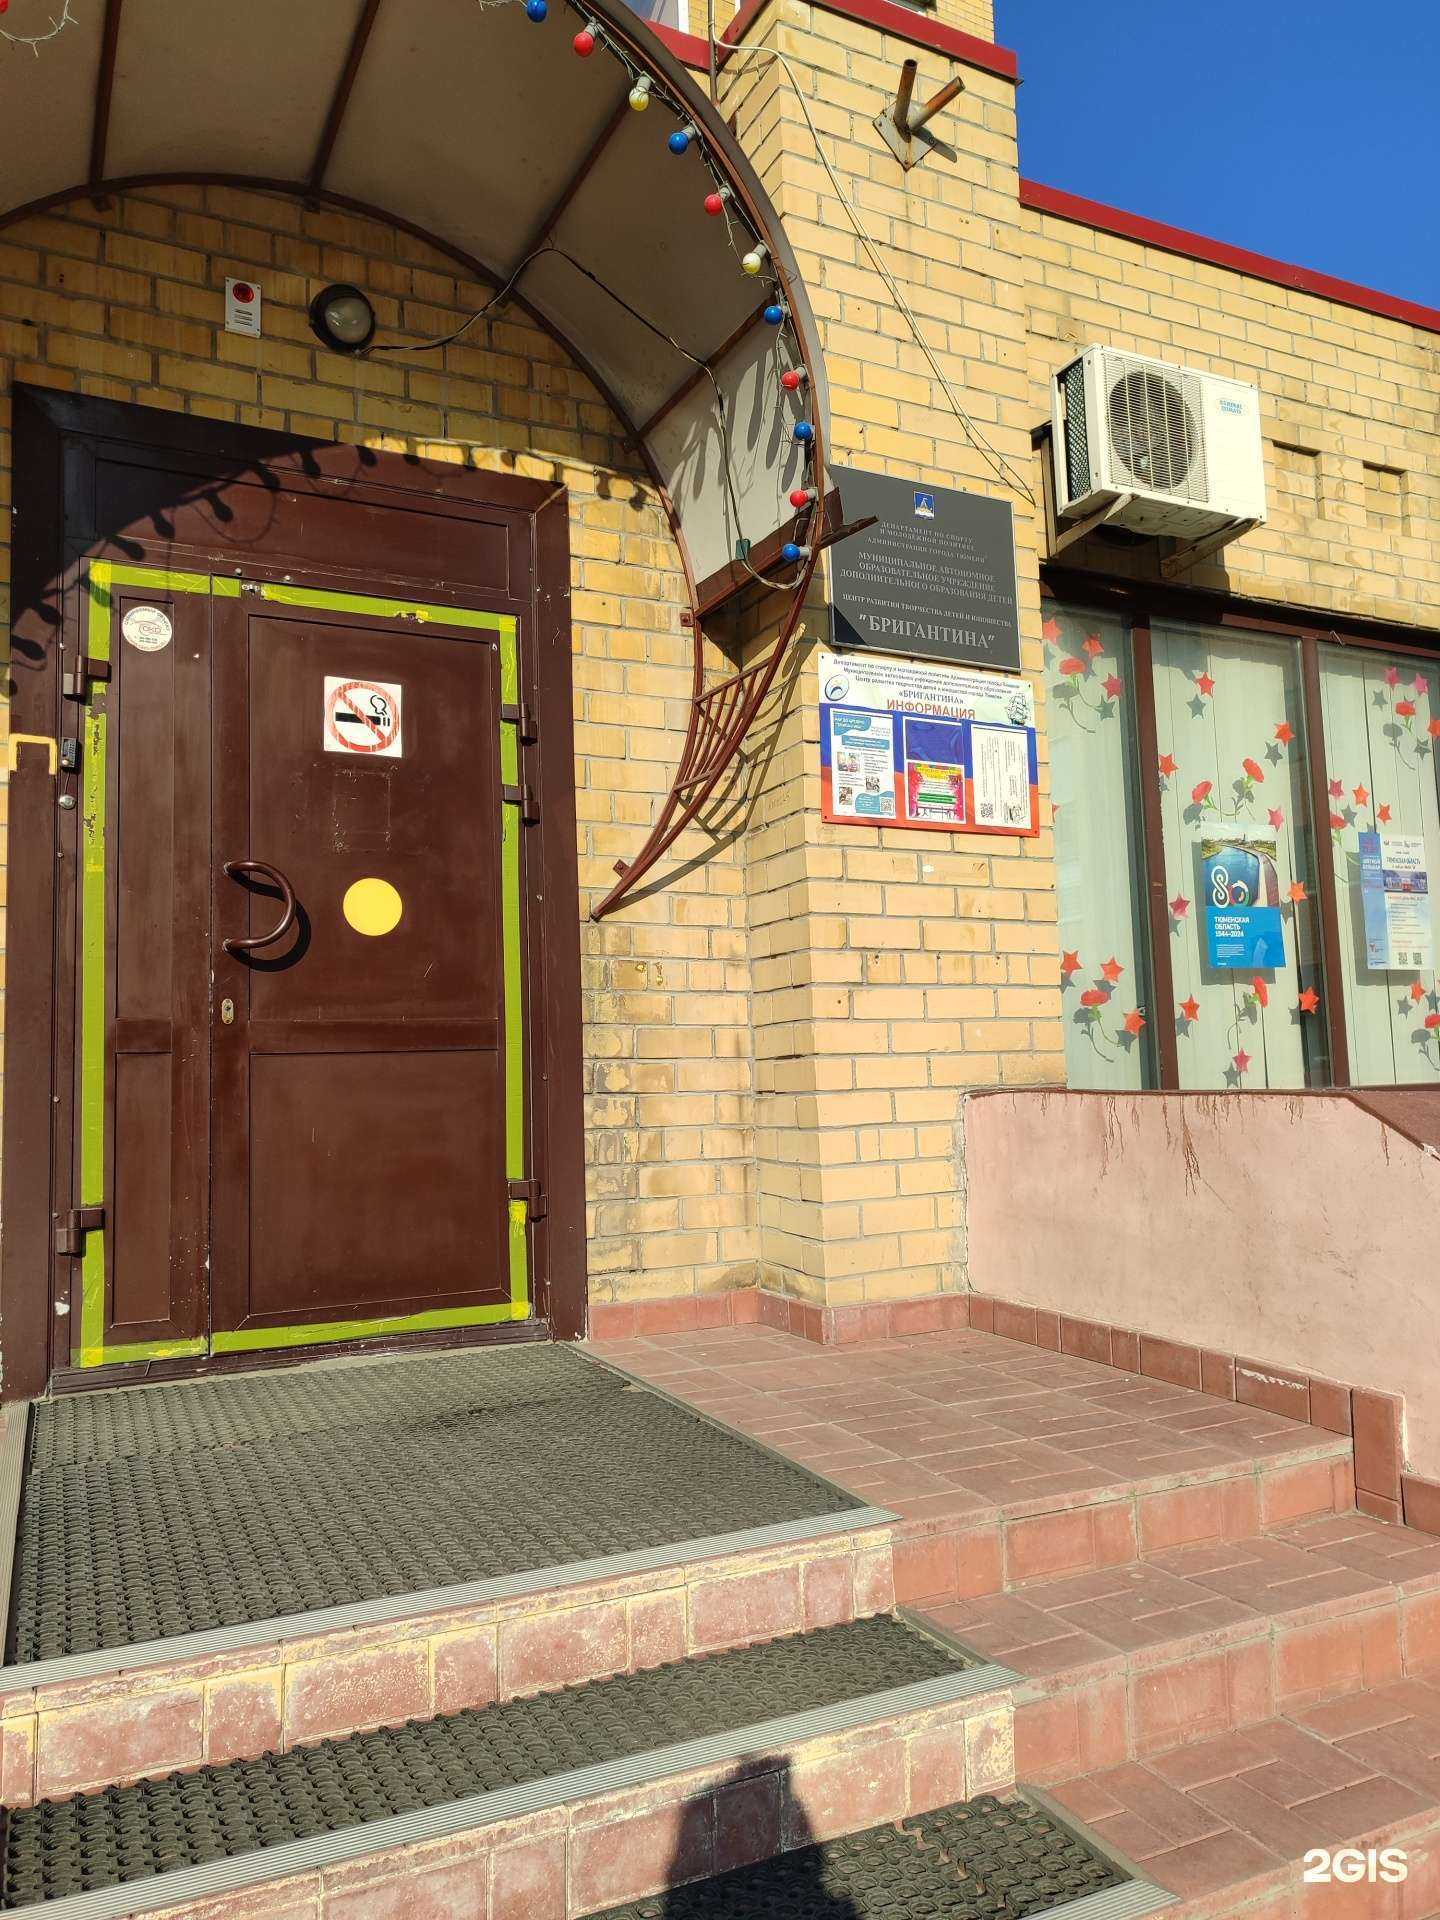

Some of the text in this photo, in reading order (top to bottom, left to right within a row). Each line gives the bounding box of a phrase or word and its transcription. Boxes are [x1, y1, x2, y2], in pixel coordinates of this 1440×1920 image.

[858, 552, 994, 582] МУНИЦИПАЛЬНОЕ АВТОНОМНОЕ
[859, 561, 939, 582] ОБРАЗОВАТЕЛЬНОЕ
[840, 568, 928, 590] ДОПОЛНИТЕЛЬНОГО
[929, 583, 987, 600] ОБРАЗОВАНИЯ
[842, 593, 866, 602] ЦЕНТР
[866, 597, 900, 609] РАЗВИТИЯ
[901, 602, 943, 616] ТВОРЧЕСТВА
[943, 610, 964, 620] ДЕТЕЙ
[859, 613, 996, 648] "БРИГАНТИНА"
[887, 699, 976, 720] ИНФОРМАЦИЯ
[899, 690, 964, 704] «БРИГАНТИНА»
